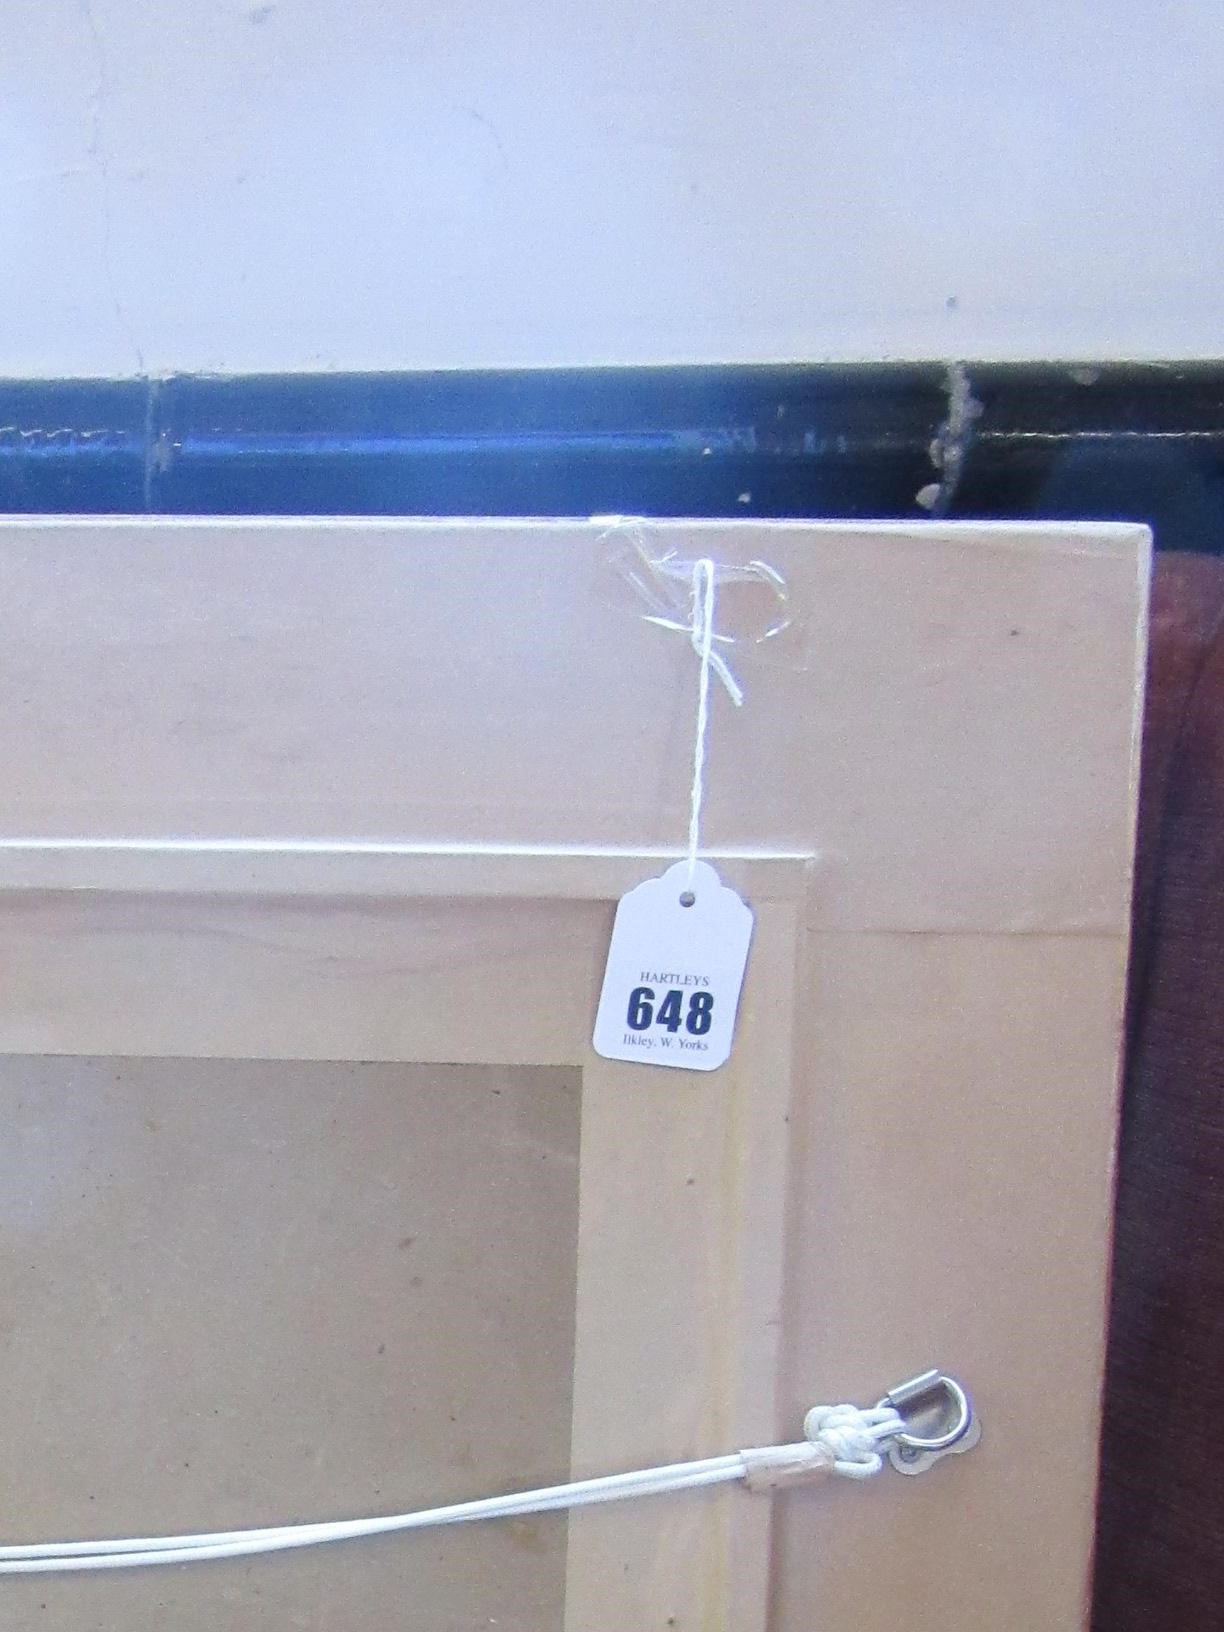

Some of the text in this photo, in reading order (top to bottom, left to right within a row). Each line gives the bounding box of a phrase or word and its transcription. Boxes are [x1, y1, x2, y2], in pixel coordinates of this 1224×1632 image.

[640, 971, 710, 987] HARTLEYS
[627, 987, 714, 1035] 648
[678, 1038, 710, 1051] Yorks
